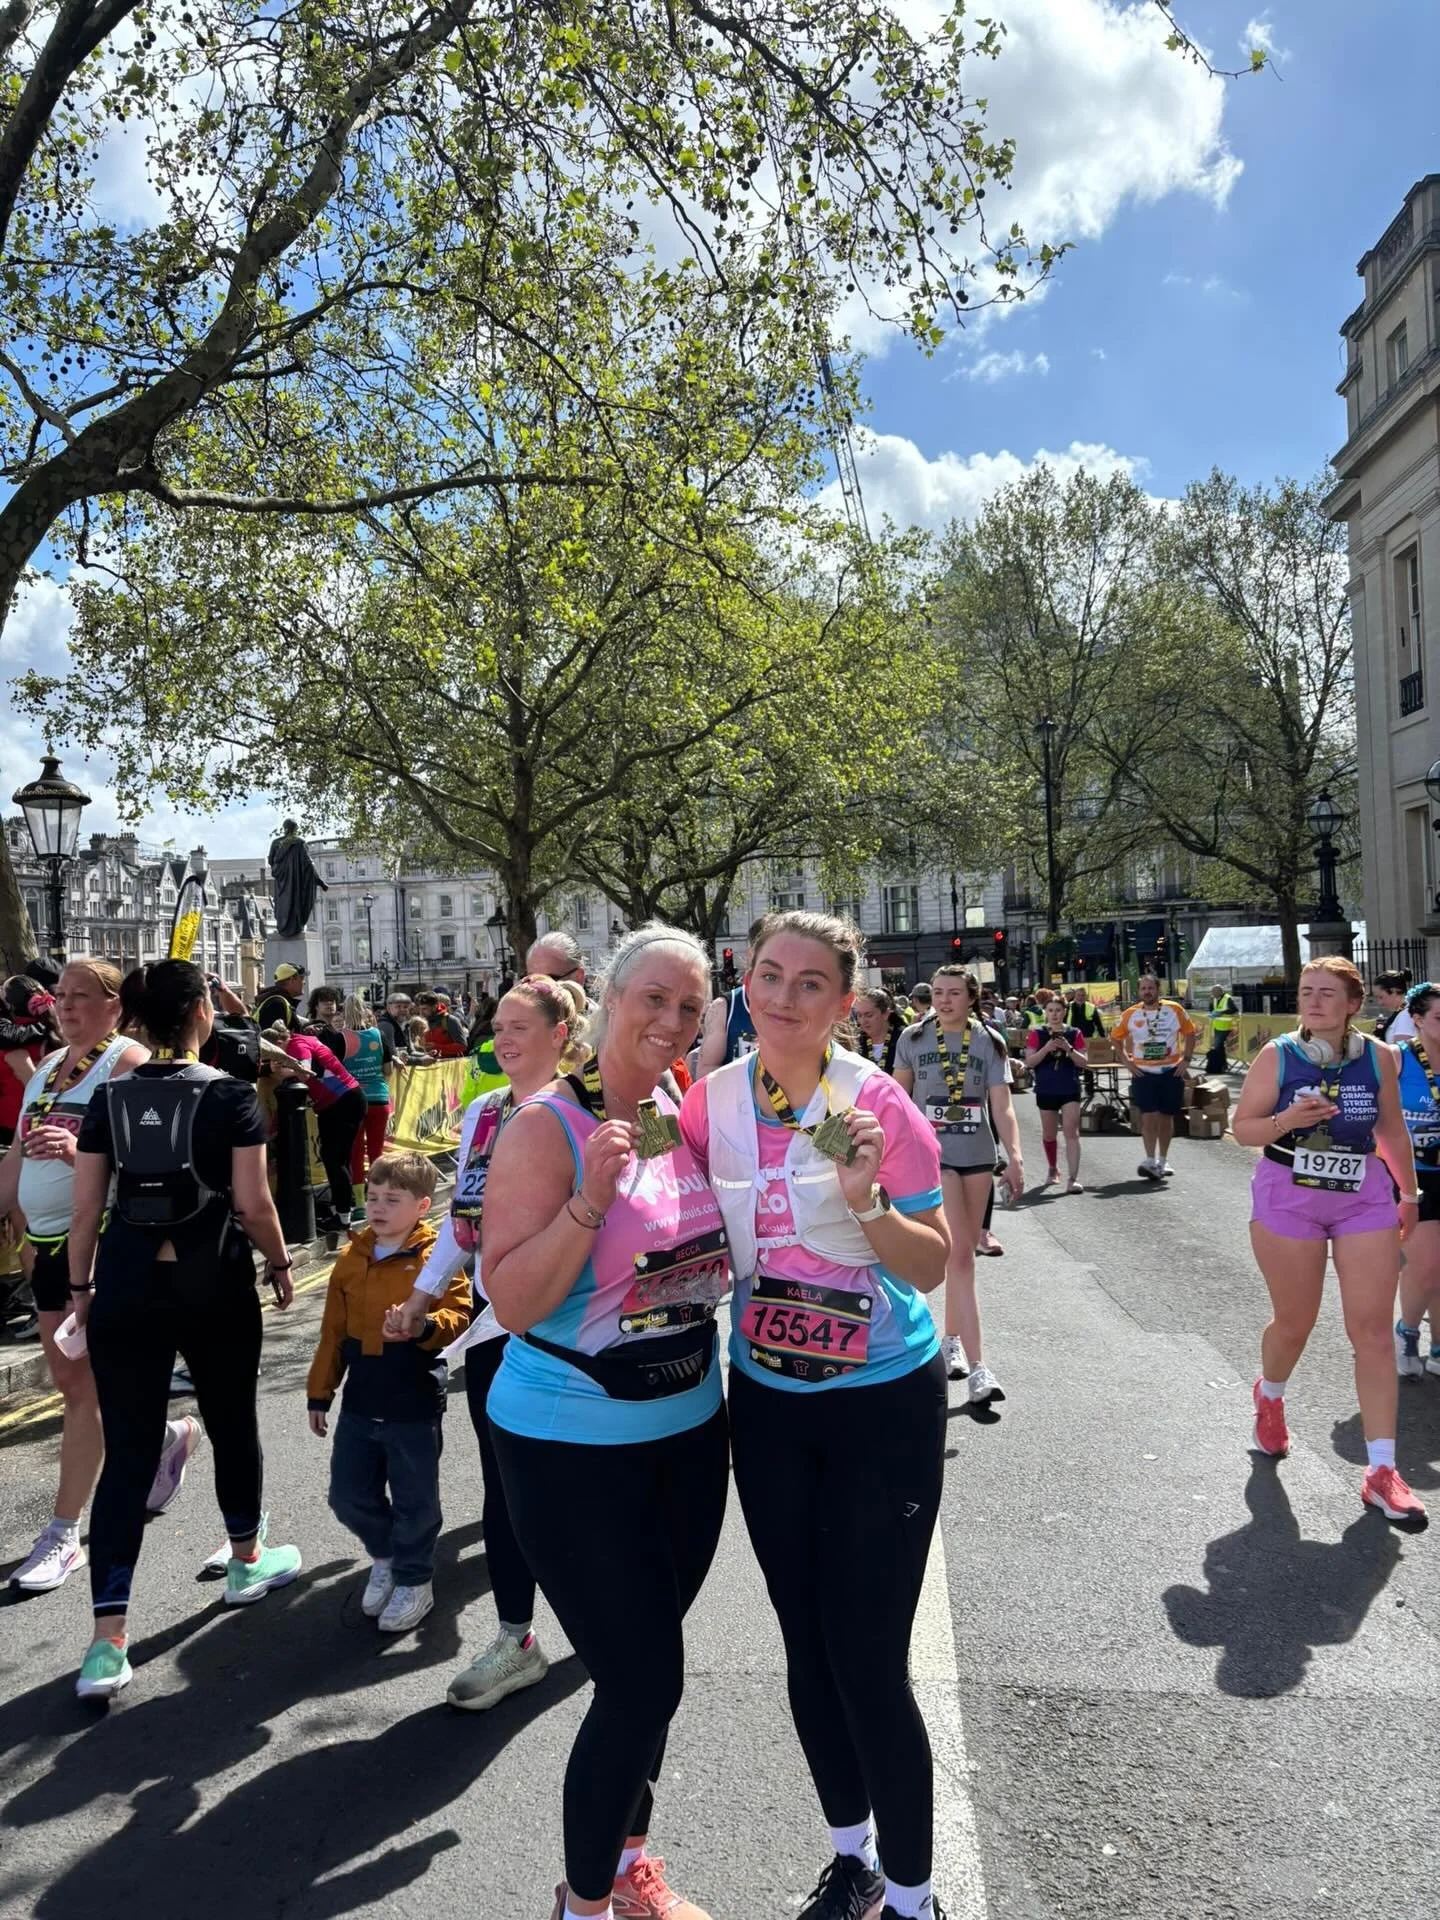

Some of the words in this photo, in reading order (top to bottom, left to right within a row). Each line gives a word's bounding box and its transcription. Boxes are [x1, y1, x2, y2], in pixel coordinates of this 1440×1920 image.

[1300, 1153, 1362, 1176] 19787
[676, 1244, 700, 1260] BECCA
[787, 1287, 823, 1302] KAELA
[753, 1306, 860, 1352] 15547
